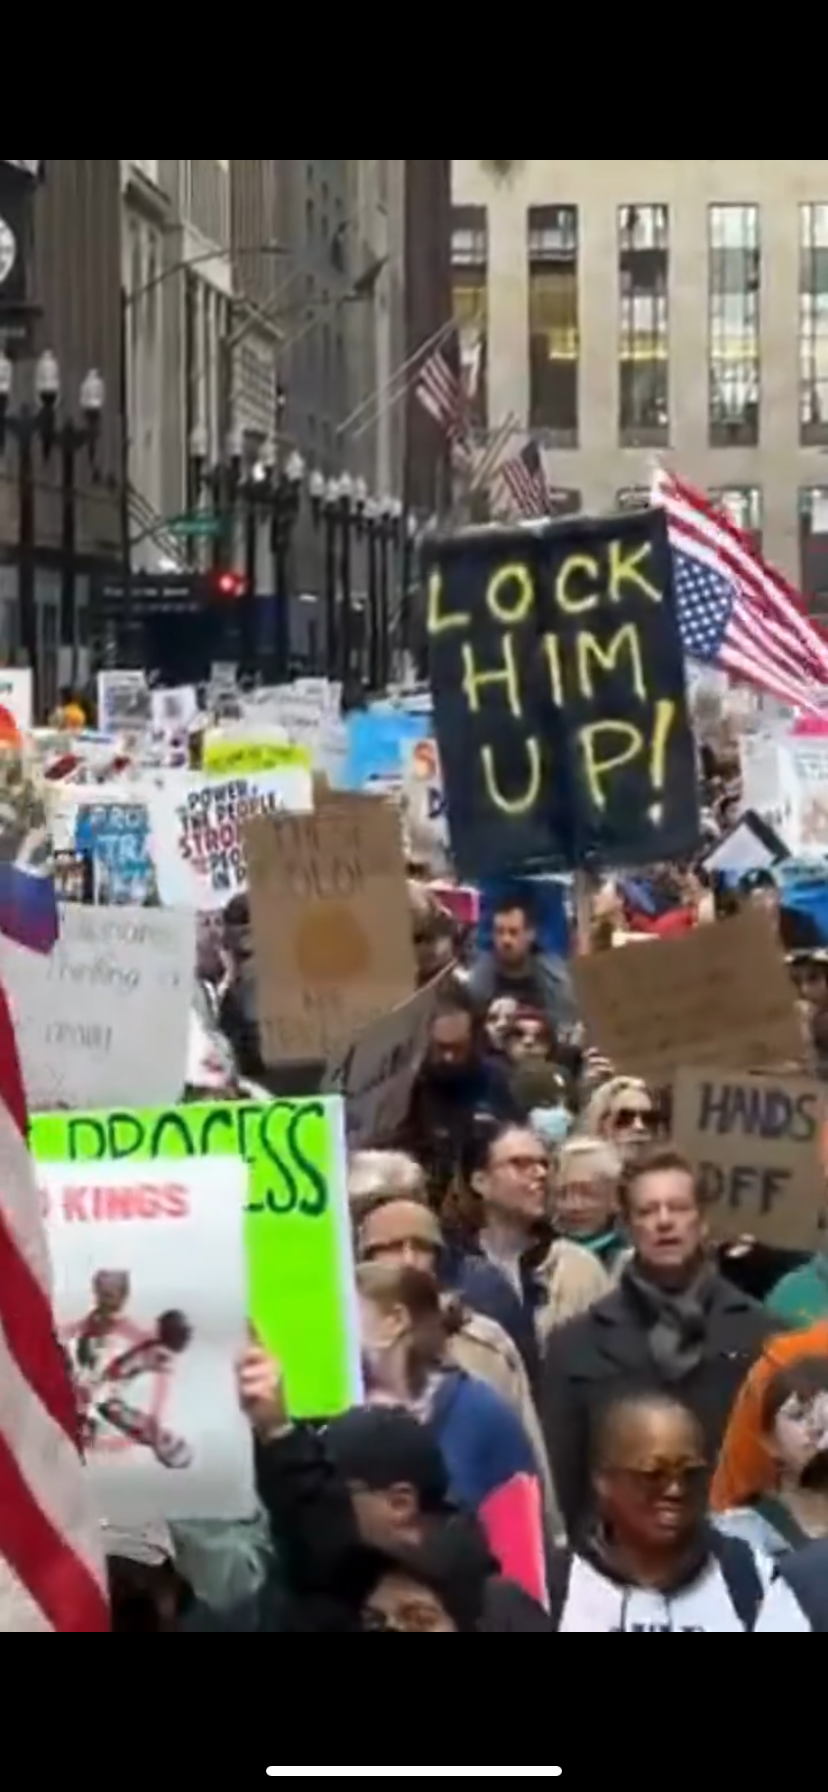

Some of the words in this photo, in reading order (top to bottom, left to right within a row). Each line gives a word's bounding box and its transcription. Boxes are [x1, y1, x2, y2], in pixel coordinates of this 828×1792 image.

[427, 539, 663, 634] LOCK
[461, 624, 646, 718] HIM
[481, 699, 676, 826] UP!
[91, 805, 146, 831] PRO
[179, 822, 240, 860] STRO
[210, 846, 242, 871] PEO
[699, 1081, 817, 1142] HANDS
[62, 1183, 190, 1222] KINGS
